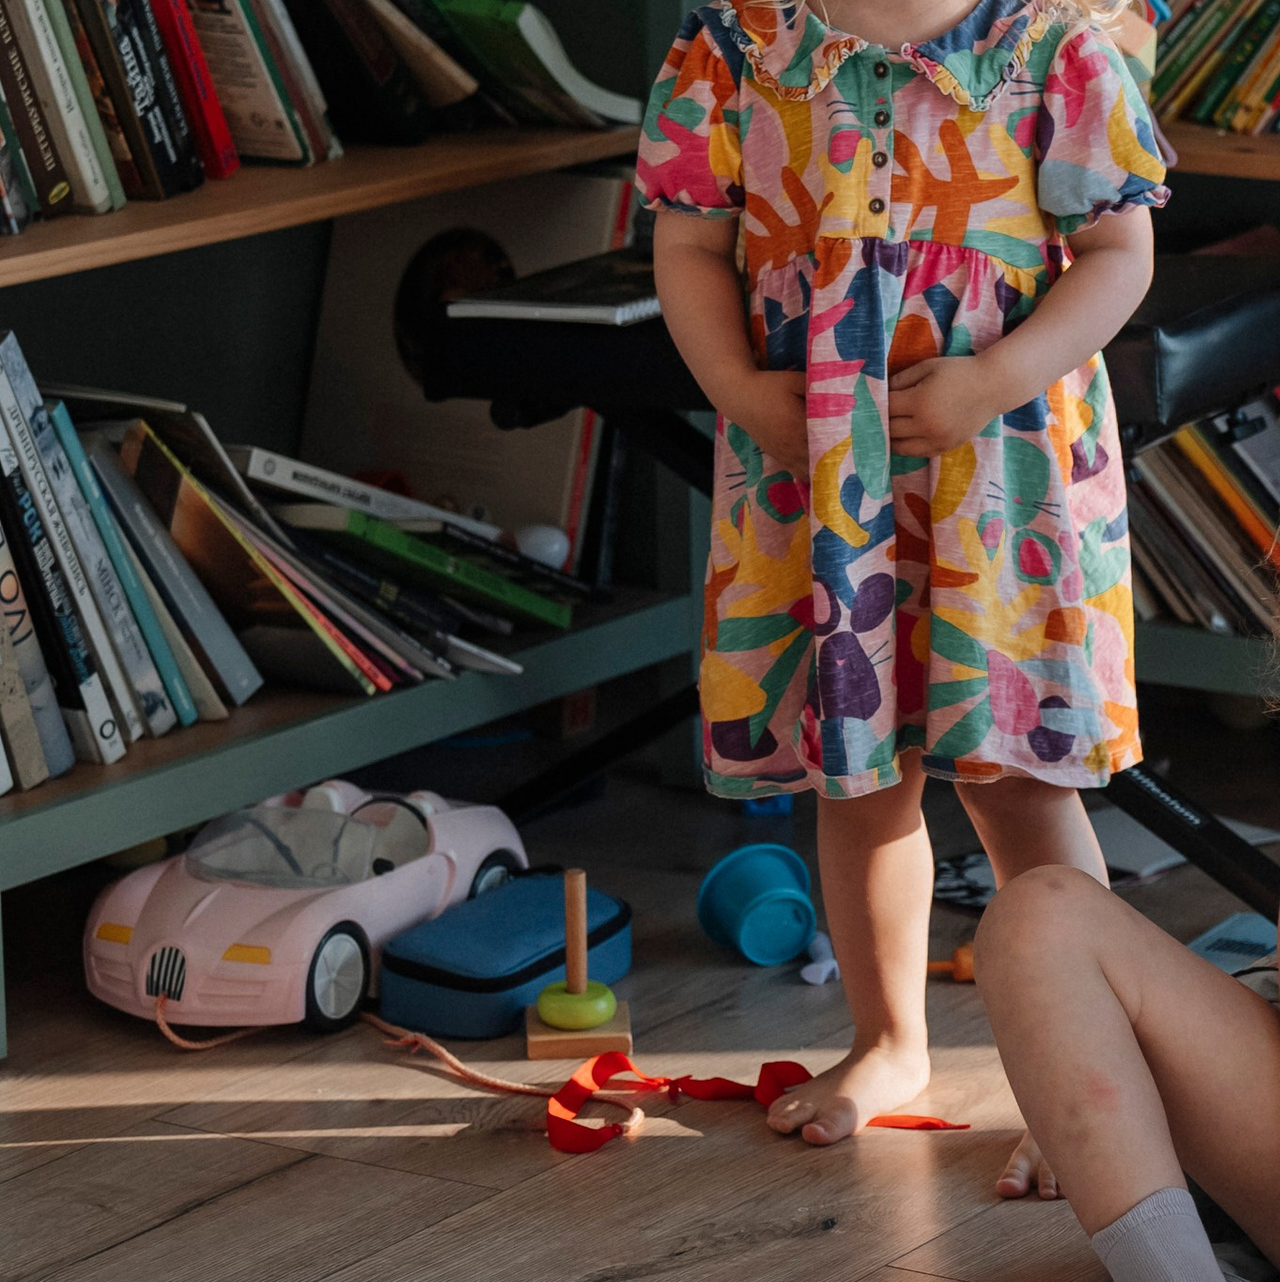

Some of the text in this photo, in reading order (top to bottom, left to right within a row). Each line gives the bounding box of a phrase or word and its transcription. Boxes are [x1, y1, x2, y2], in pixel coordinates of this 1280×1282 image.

[8, 49, 55, 169] ПЕТЕРБУРГСКИЕ
[115, 37, 149, 115] Тайна
[7, 405, 59, 516] ДРЕВНЕРУССКАЯ
[52, 518, 90, 596] ЖИВОПИСЬ
[13, 493, 47, 545] РОК
